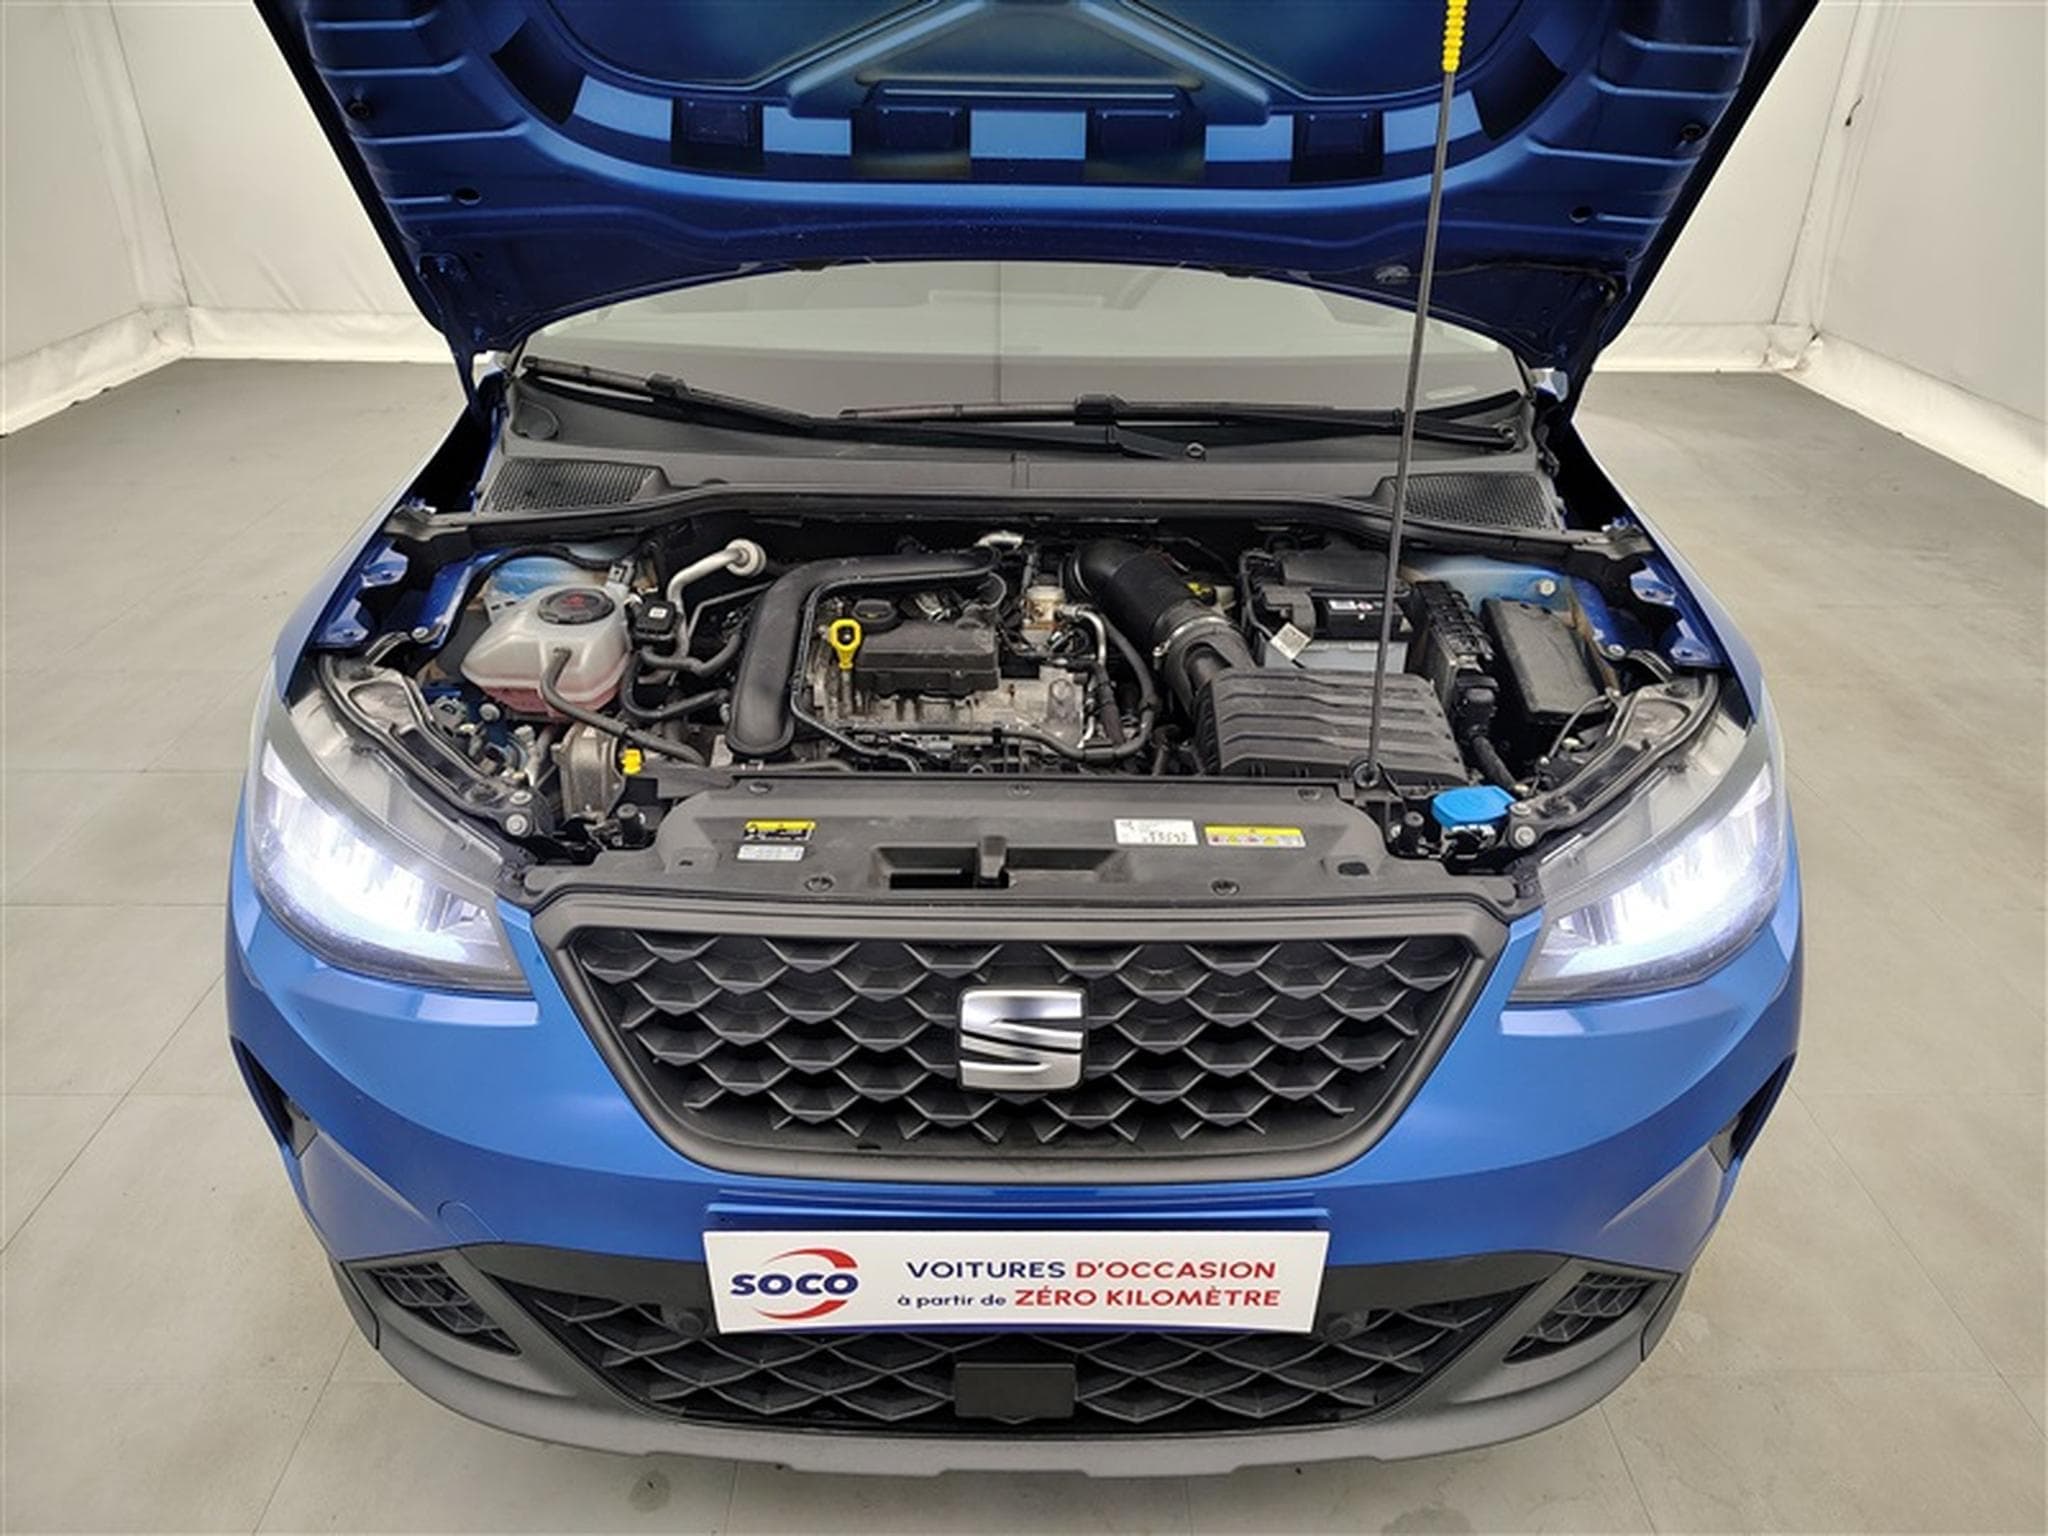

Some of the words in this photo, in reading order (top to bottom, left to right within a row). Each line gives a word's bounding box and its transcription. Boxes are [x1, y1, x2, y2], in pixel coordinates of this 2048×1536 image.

[906, 1261, 1066, 1279] VOITURES
[1075, 1261, 1276, 1279] D'OCCASION
[730, 1273, 859, 1296] SOCO
[897, 1290, 911, 1306] à
[916, 1293, 974, 1309] partir
[980, 1293, 1007, 1306] de
[1015, 1285, 1097, 1307] ZÉRO
[1106, 1285, 1281, 1307] KILOMÈTRE
